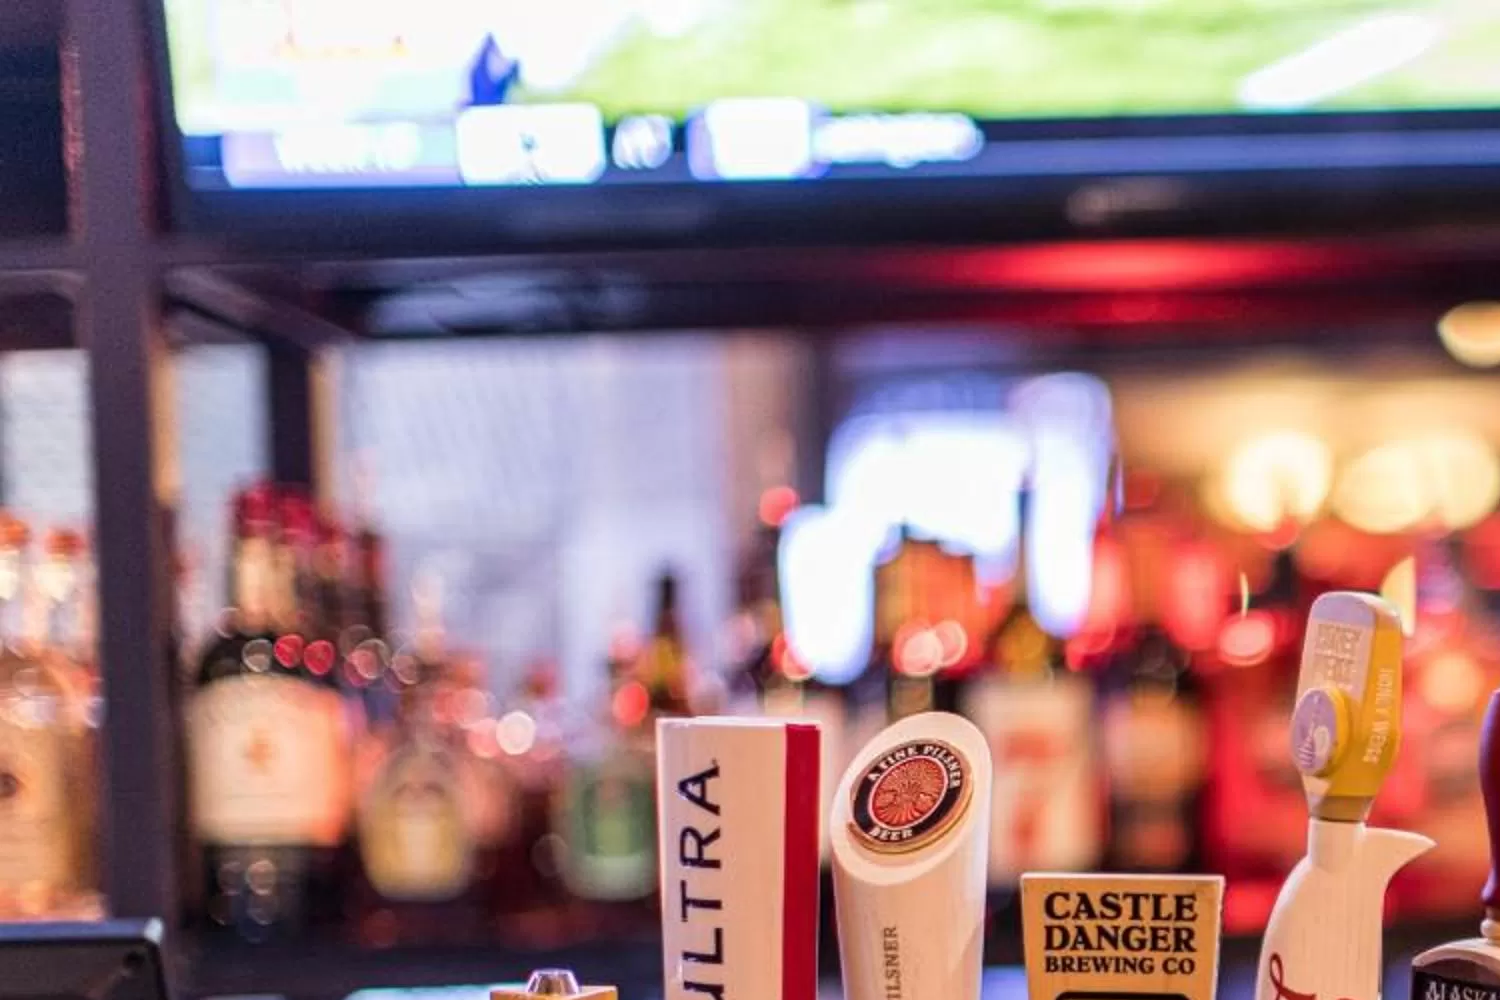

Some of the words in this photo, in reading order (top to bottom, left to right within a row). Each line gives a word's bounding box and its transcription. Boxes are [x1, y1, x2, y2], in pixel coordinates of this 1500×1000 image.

[924, 745, 961, 788] PILSNER
[869, 826, 913, 841] BEER
[1044, 892, 1198, 922] CASTLE
[1044, 925, 1197, 953] DANGER
[1044, 955, 1155, 975] BREWING
[1162, 957, 1195, 975] CO
